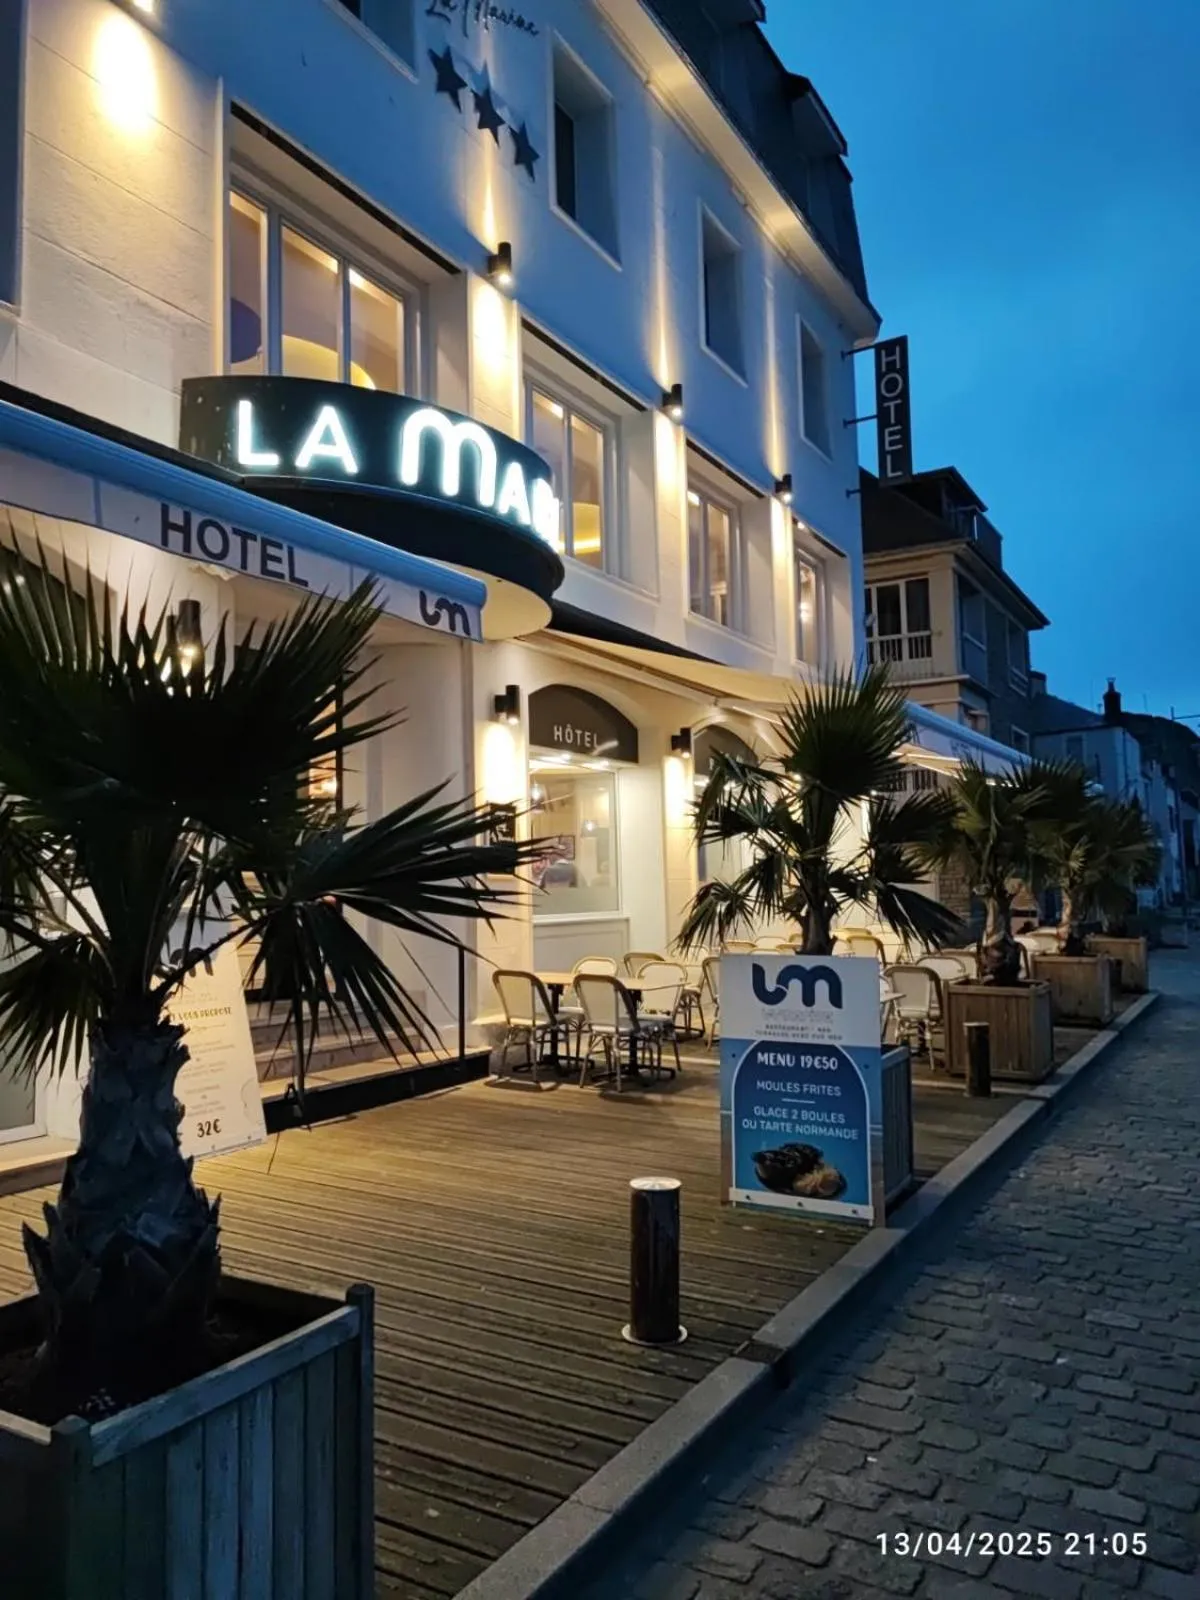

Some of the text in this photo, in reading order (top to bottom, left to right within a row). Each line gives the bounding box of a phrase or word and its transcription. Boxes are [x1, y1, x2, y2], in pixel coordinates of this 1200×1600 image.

[880, 345, 903, 477] HOTEL
[237, 399, 358, 473] LA
[160, 503, 309, 588] HOTEL
[757, 1052, 838, 1070] MENU 19€50
[756, 1080, 842, 1097] MOULES FRITES
[753, 1106, 846, 1124] GLACE 2 BOULES
[197, 1118, 222, 1138] 32€
[742, 1118, 860, 1140] OU TARTE NORMANDE
